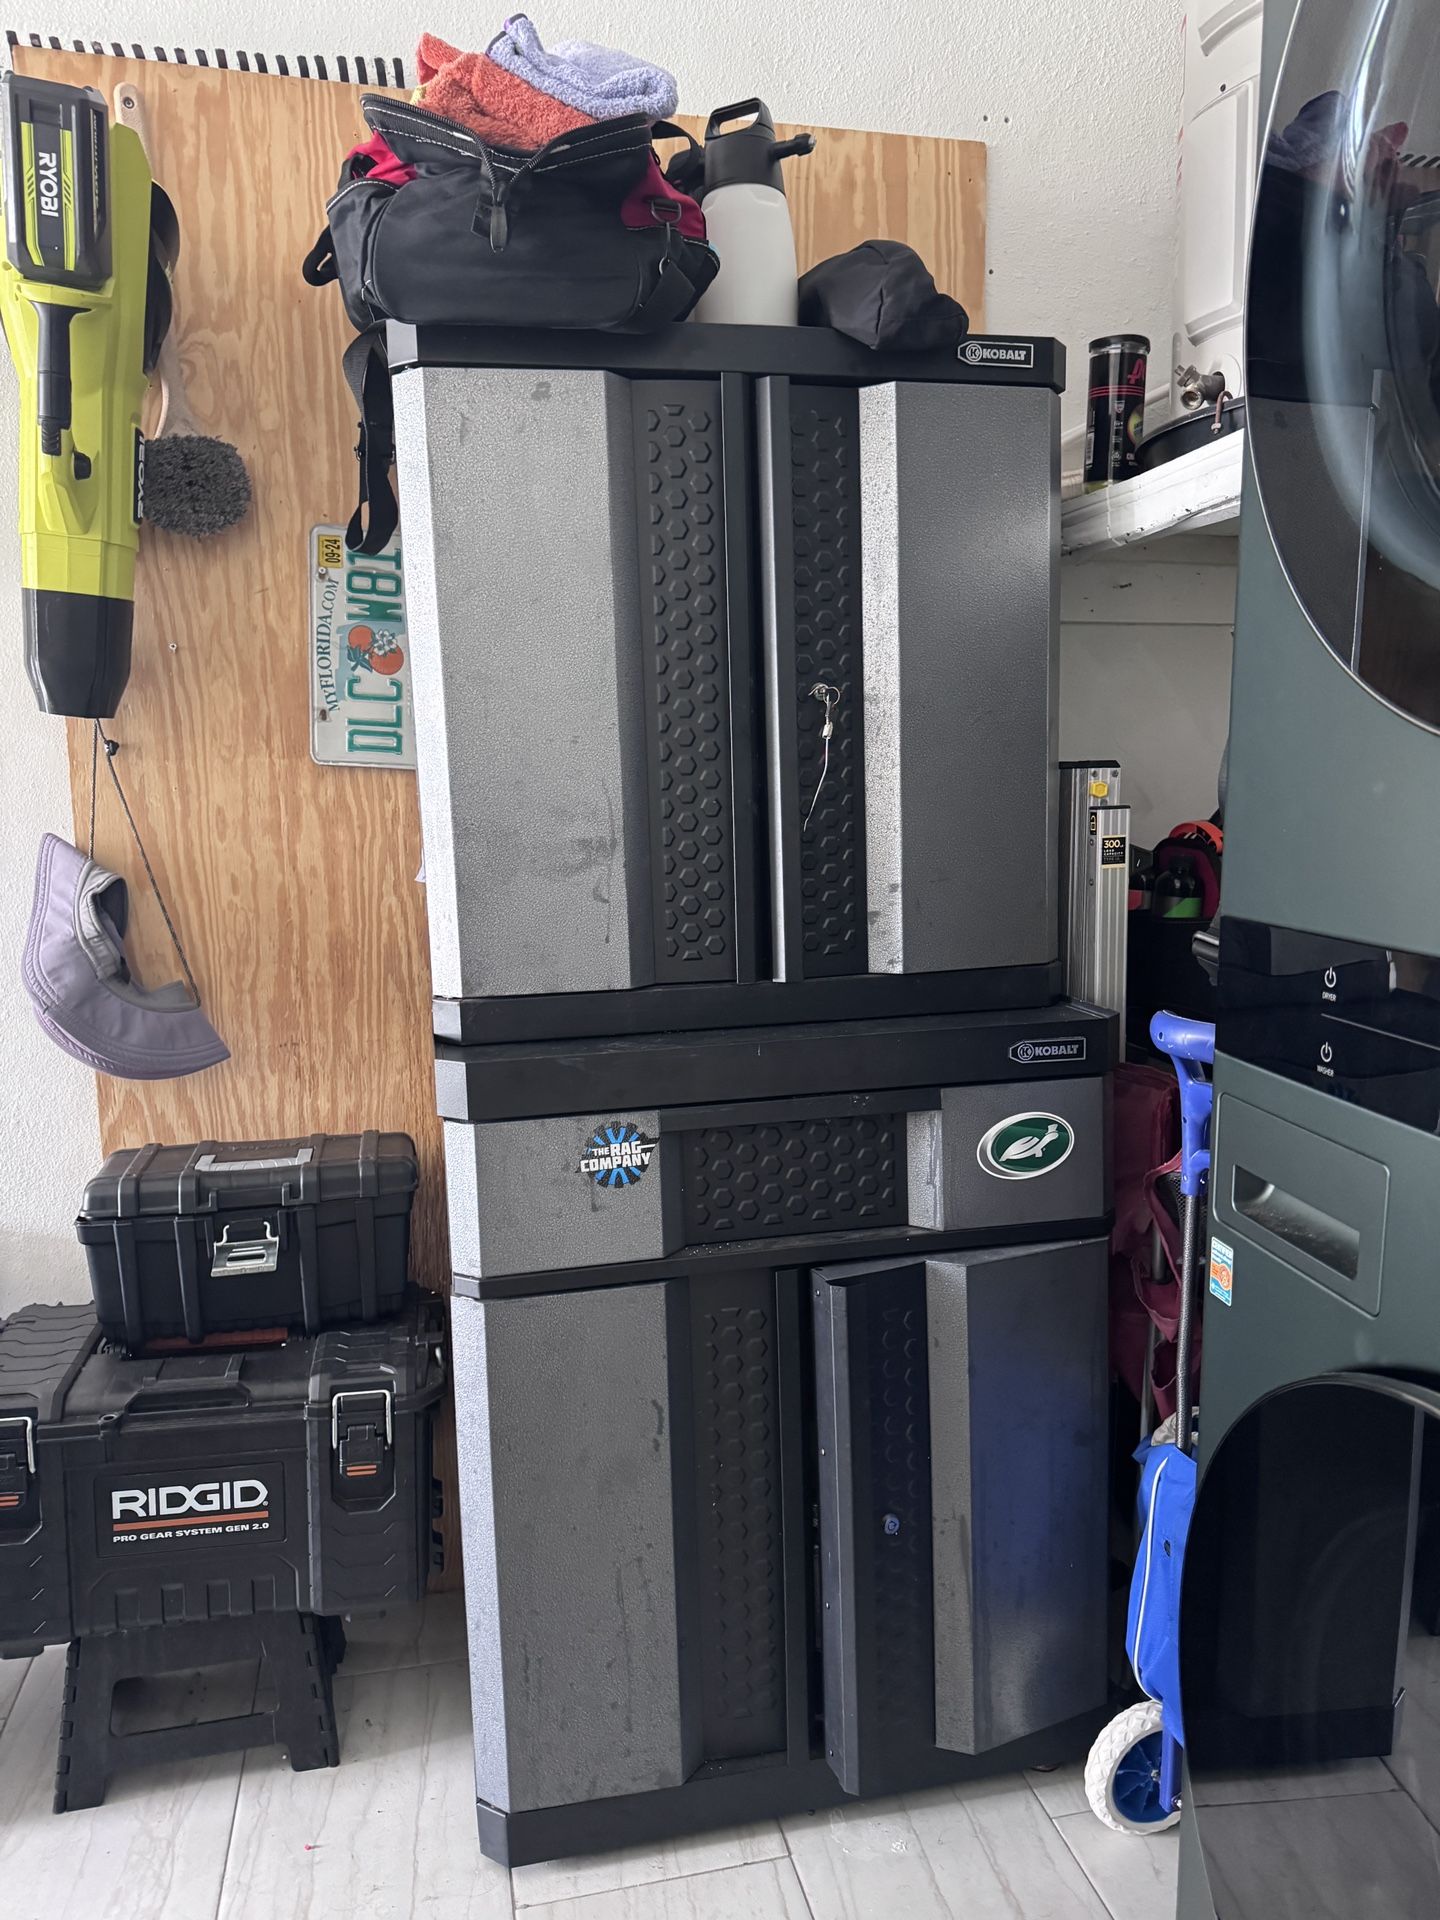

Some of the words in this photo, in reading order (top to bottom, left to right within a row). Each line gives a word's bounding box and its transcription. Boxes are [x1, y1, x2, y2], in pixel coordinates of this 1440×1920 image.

[38, 151, 59, 217] RYOBI
[982, 348, 1026, 361] KOBALT
[324, 538, 341, 563] 09-24
[316, 578, 340, 712] MYFLORIDA.COM
[346, 675, 402, 755] DLC
[1321, 991, 1337, 1002] DRYER
[1034, 1044, 1079, 1056] KOBALT
[1316, 1064, 1335, 1078] WASHER
[591, 1146, 610, 1156] THE
[609, 1140, 655, 1157] RAG
[580, 1152, 651, 1173] COMPANY
[111, 1479, 268, 1520] RIDGID
[112, 1533, 137, 1543] PRO
[140, 1531, 173, 1541] GEAR
[175, 1526, 223, 1537] SYSTEM
[225, 1523, 250, 1533] GEN
[252, 1522, 270, 1530] 2.0
